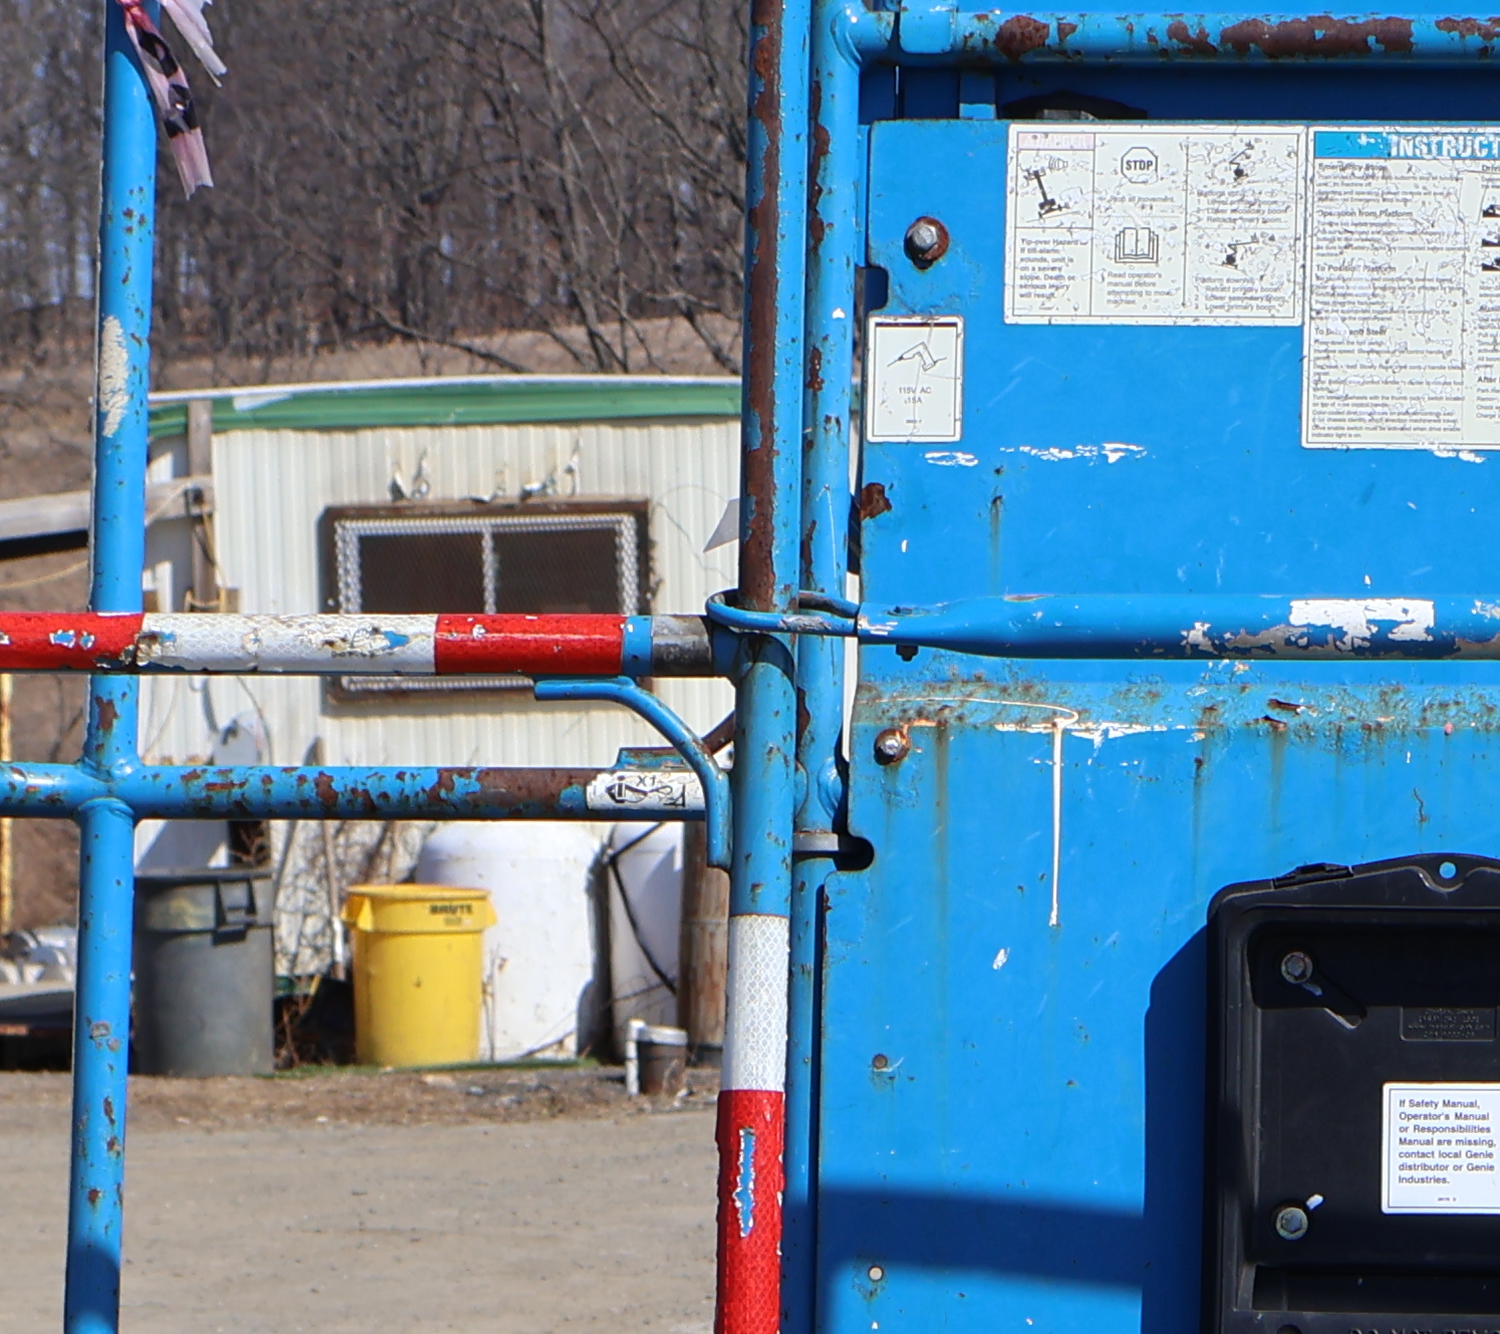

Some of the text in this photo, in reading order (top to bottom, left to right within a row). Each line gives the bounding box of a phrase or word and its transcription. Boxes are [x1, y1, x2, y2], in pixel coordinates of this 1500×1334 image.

[1126, 160, 1153, 171] STOP
[1107, 271, 1163, 280] Read operator's
[1135, 279, 1157, 287] before
[1477, 376, 1497, 384] After
[636, 775, 657, 786] X1
[1399, 1099, 1480, 1110] If Safety Manual,
[1399, 1112, 1489, 1122] Operator's Manual
[1413, 1124, 1491, 1135] Responsibilities
[1399, 1137, 1433, 1146] Manual
[1455, 1138, 1497, 1148] missing,
[1398, 1150, 1494, 1159] contact local Genie
[1398, 1163, 1495, 1172] distributor or Genie
[1398, 1175, 1450, 1184] Industries.
